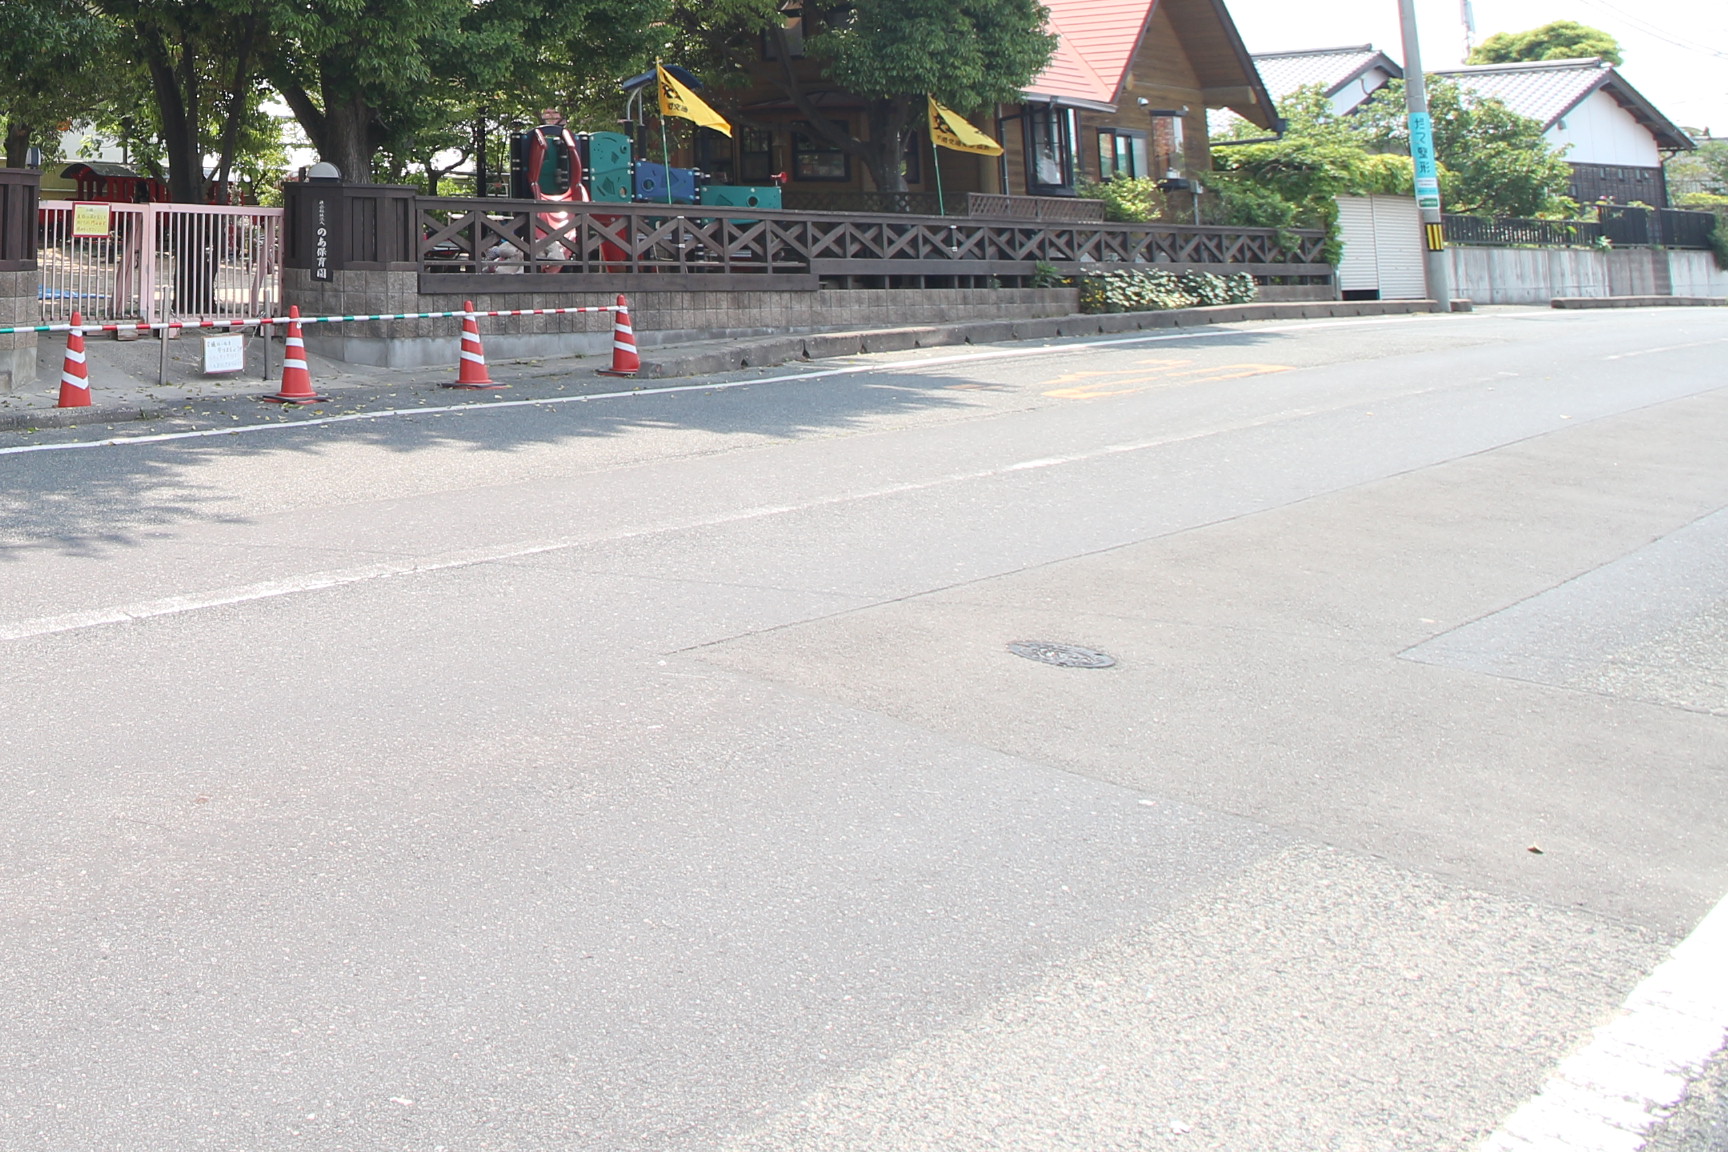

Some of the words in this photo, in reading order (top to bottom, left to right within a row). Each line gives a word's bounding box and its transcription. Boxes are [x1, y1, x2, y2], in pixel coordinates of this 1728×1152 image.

[317, 228, 327, 279] のあ保育園
